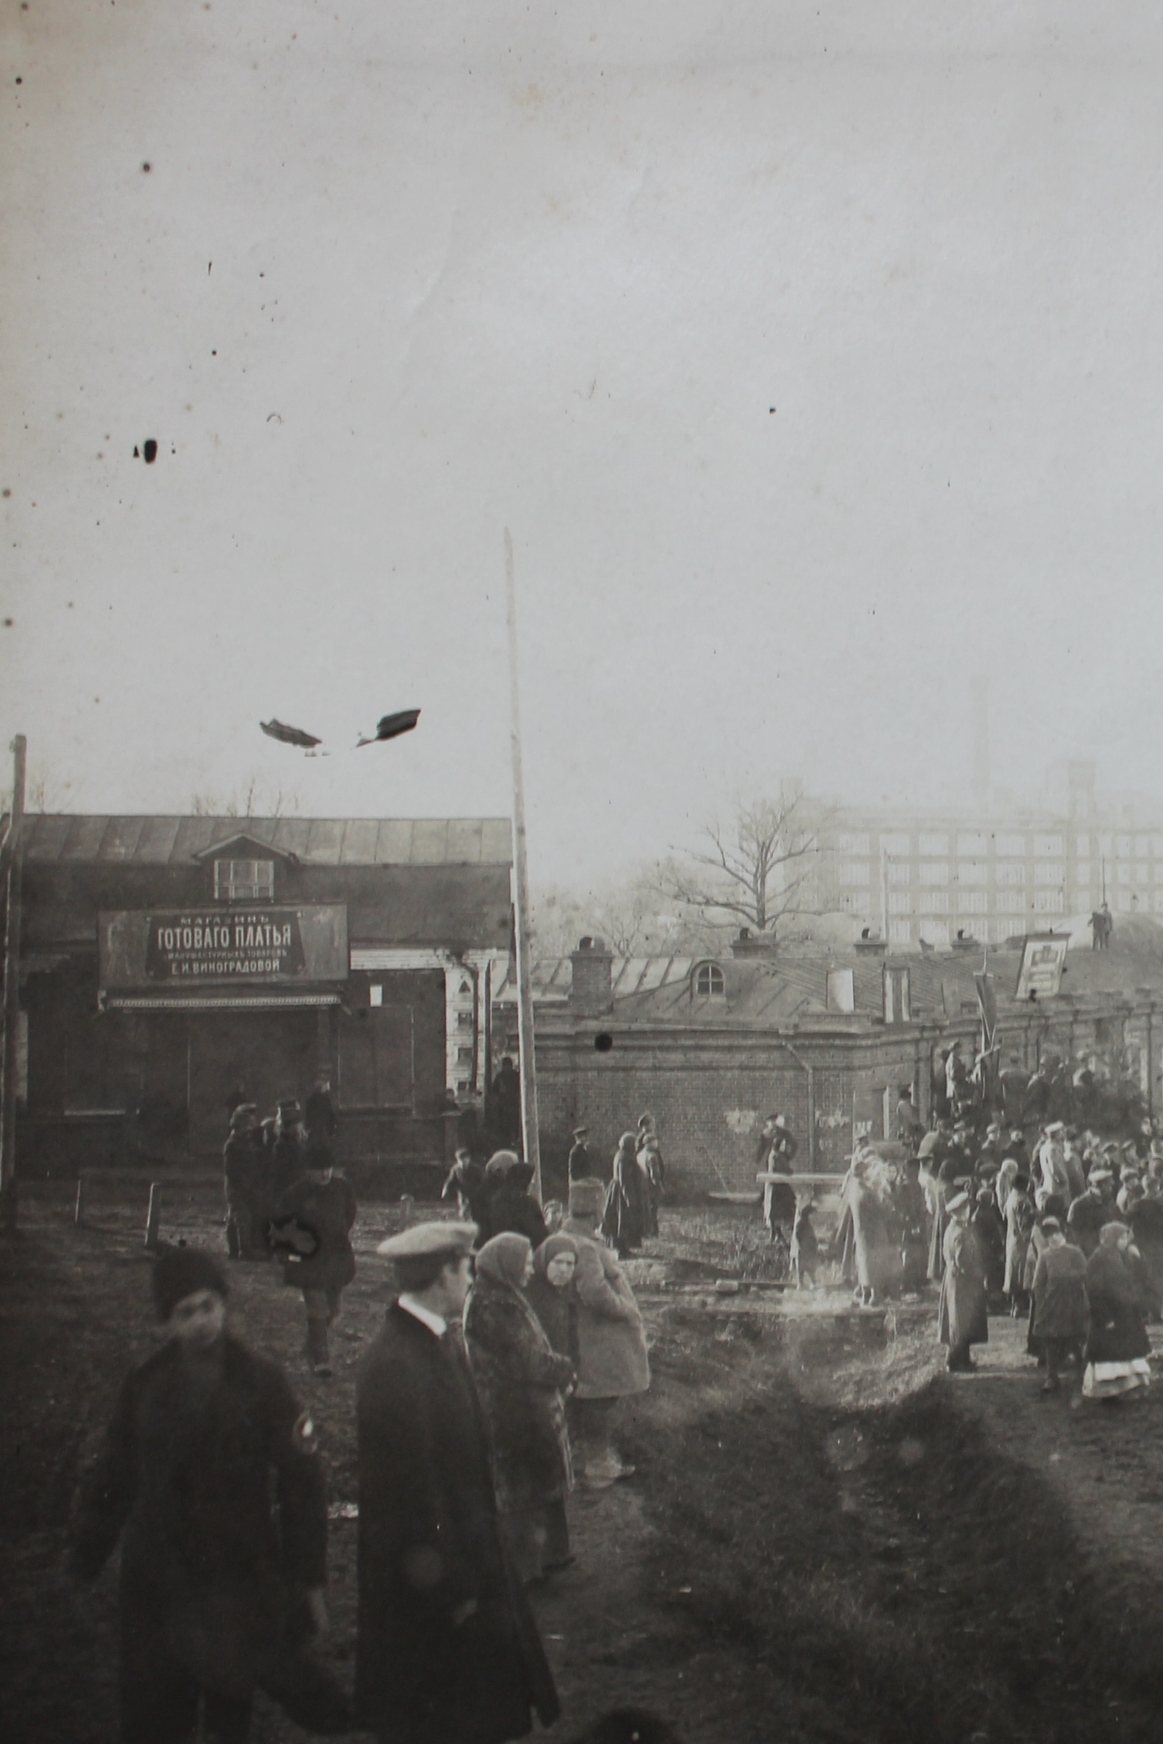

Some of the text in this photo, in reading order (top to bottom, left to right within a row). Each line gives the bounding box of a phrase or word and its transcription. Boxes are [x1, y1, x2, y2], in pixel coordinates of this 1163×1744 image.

[180, 914, 269, 925] МАГАЗИНЪ
[158, 924, 291, 949] ГОТОВАГО ПЛАТЬЯ
[193, 959, 280, 974] ВИНОГРАДОВОЙ
